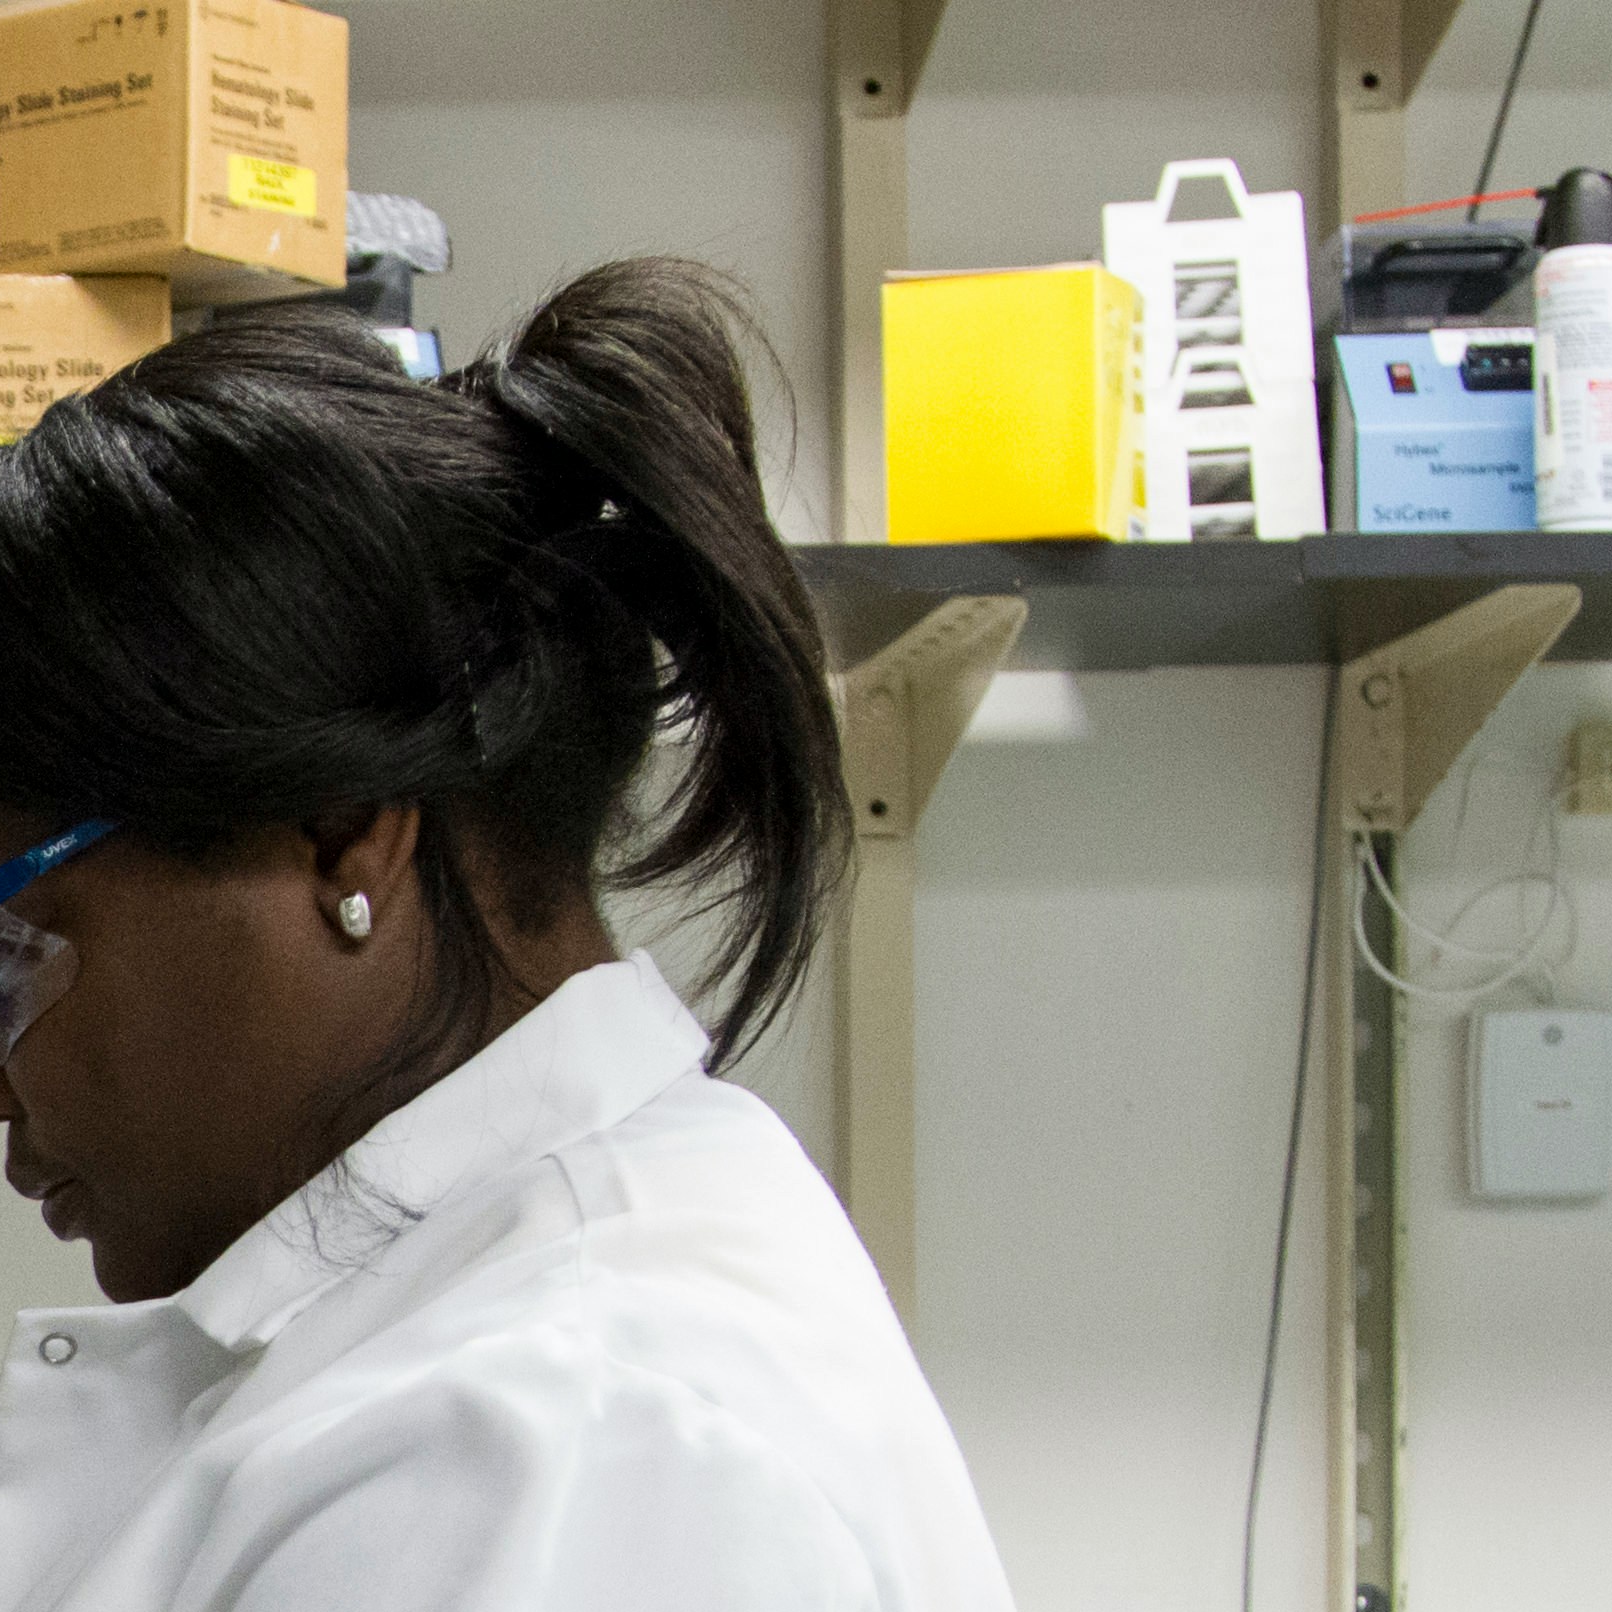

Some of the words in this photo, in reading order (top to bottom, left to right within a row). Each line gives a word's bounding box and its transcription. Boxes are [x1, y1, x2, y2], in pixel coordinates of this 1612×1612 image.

[56, 358, 104, 378] Slide
[23, 386, 55, 405] Set
[1373, 503, 1452, 523] SciGene
